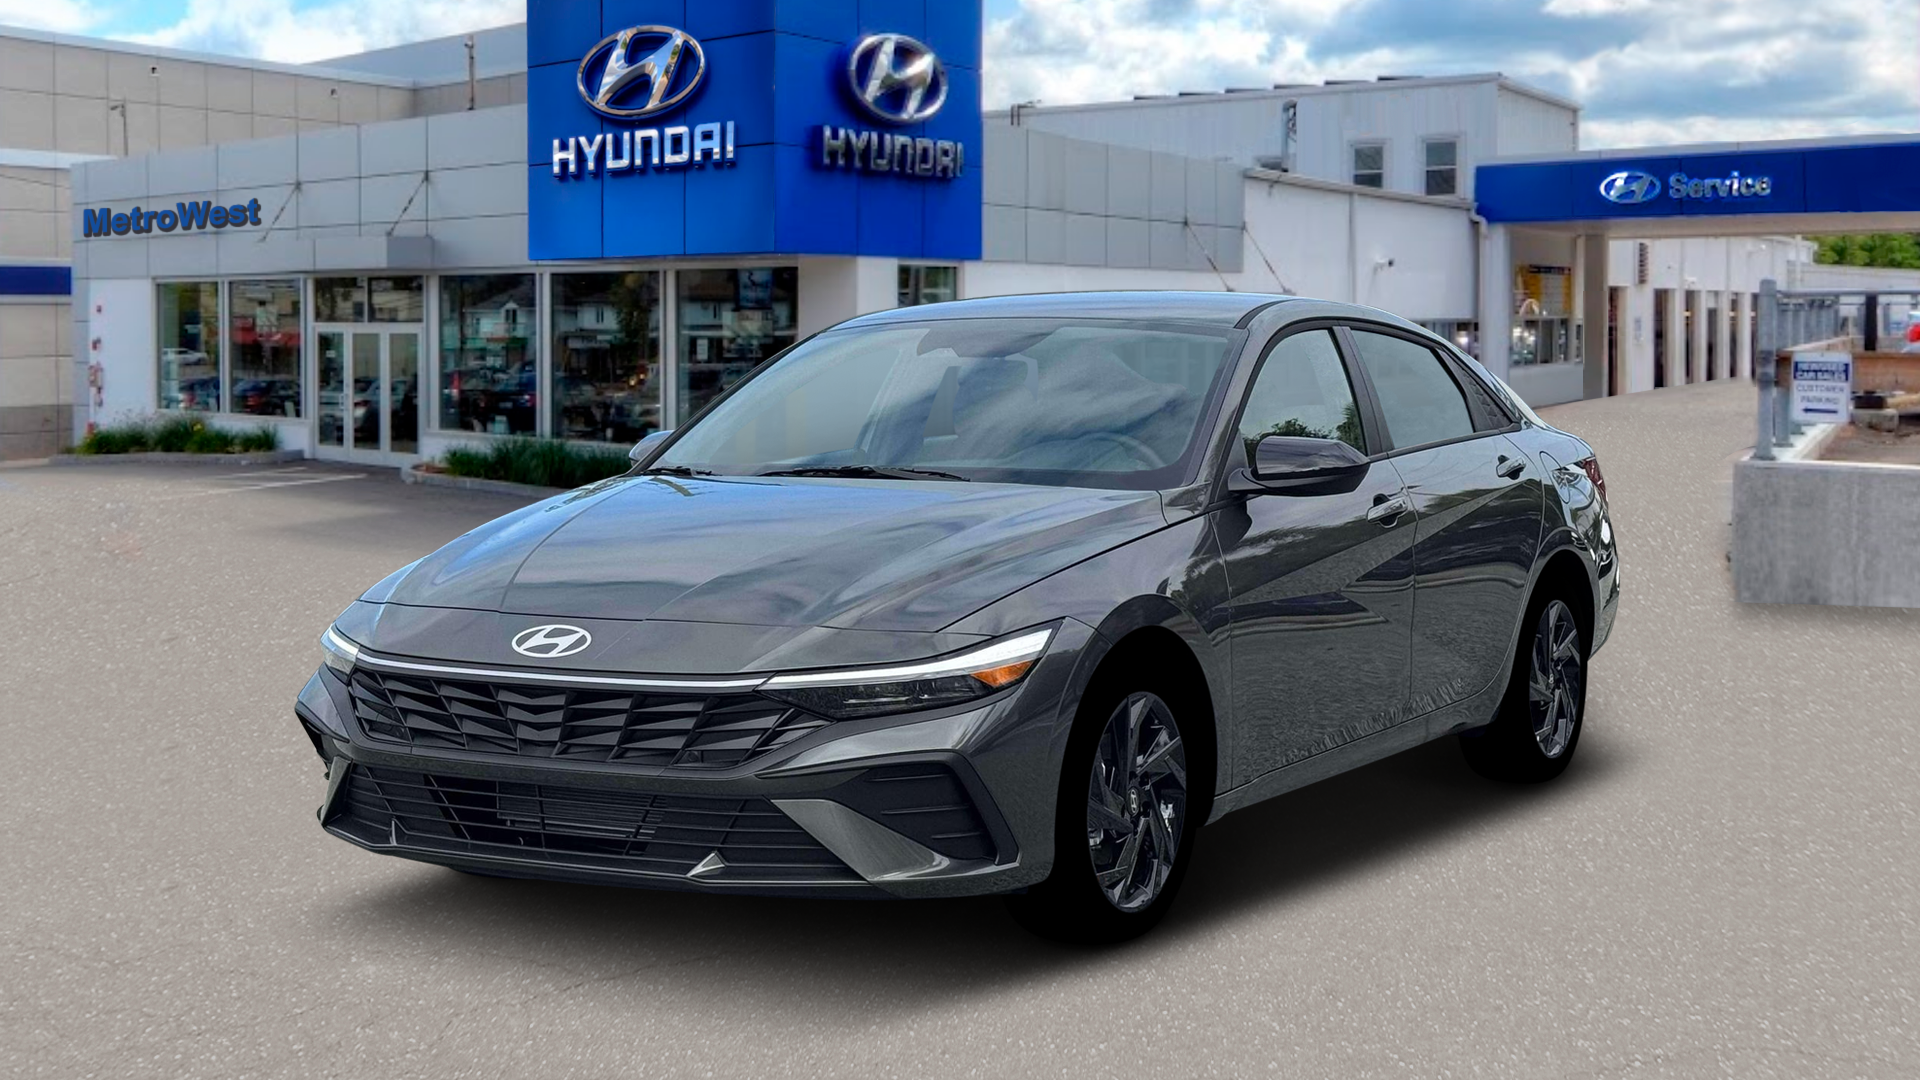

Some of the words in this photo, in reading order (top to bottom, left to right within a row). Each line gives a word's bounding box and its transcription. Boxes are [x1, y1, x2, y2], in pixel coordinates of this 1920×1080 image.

[552, 120, 736, 177] HYUNDAI
[821, 125, 964, 178] HYUNDAI
[1668, 170, 1772, 199] Service
[83, 198, 261, 237] MetroWest
